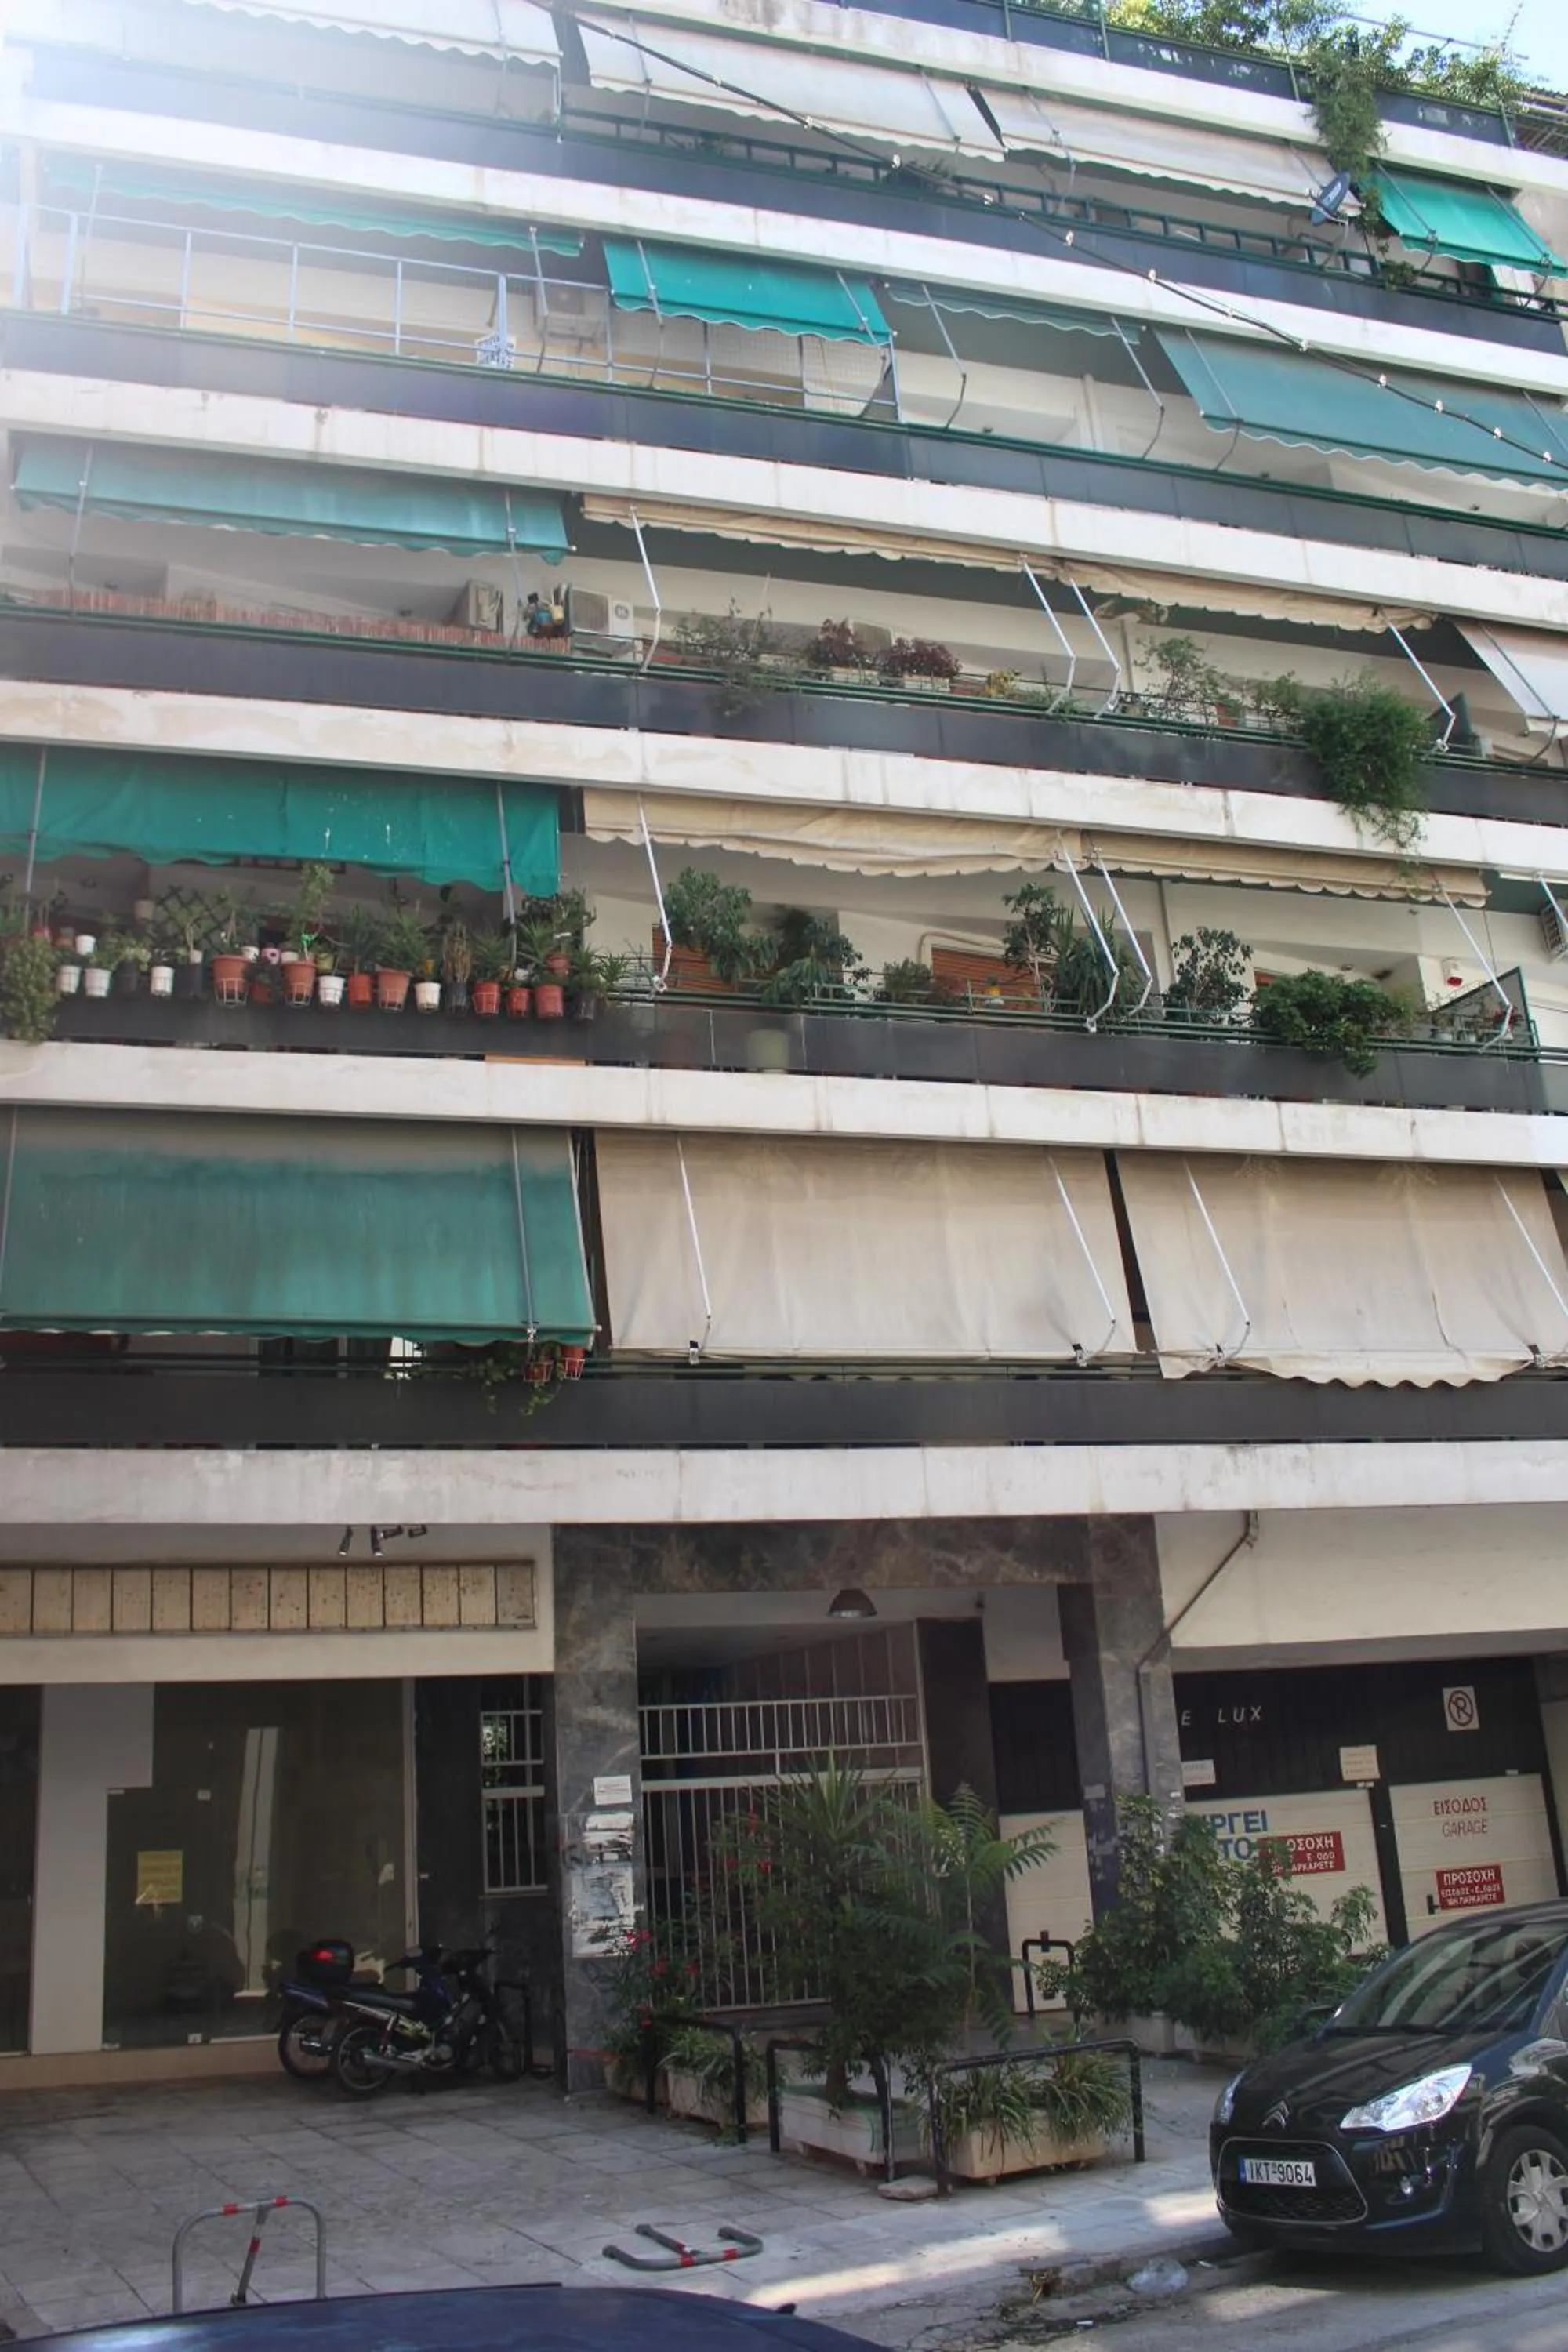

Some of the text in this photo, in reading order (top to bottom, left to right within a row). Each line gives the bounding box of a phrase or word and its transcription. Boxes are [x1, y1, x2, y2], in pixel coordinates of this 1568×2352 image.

[1218, 1705, 1262, 1723] LUX
[1434, 1796, 1488, 1816] ΕΙΣΟΔΟΣ
[1443, 1818, 1489, 1838] GARAGE
[1279, 1835, 1334, 1852] ΟΣΟΧΗ
[1290, 1861, 1335, 1872] ΑΡΚΑΡΕΤΕ
[1443, 1869, 1495, 1886] ΠΡΟΣΟΧΗ
